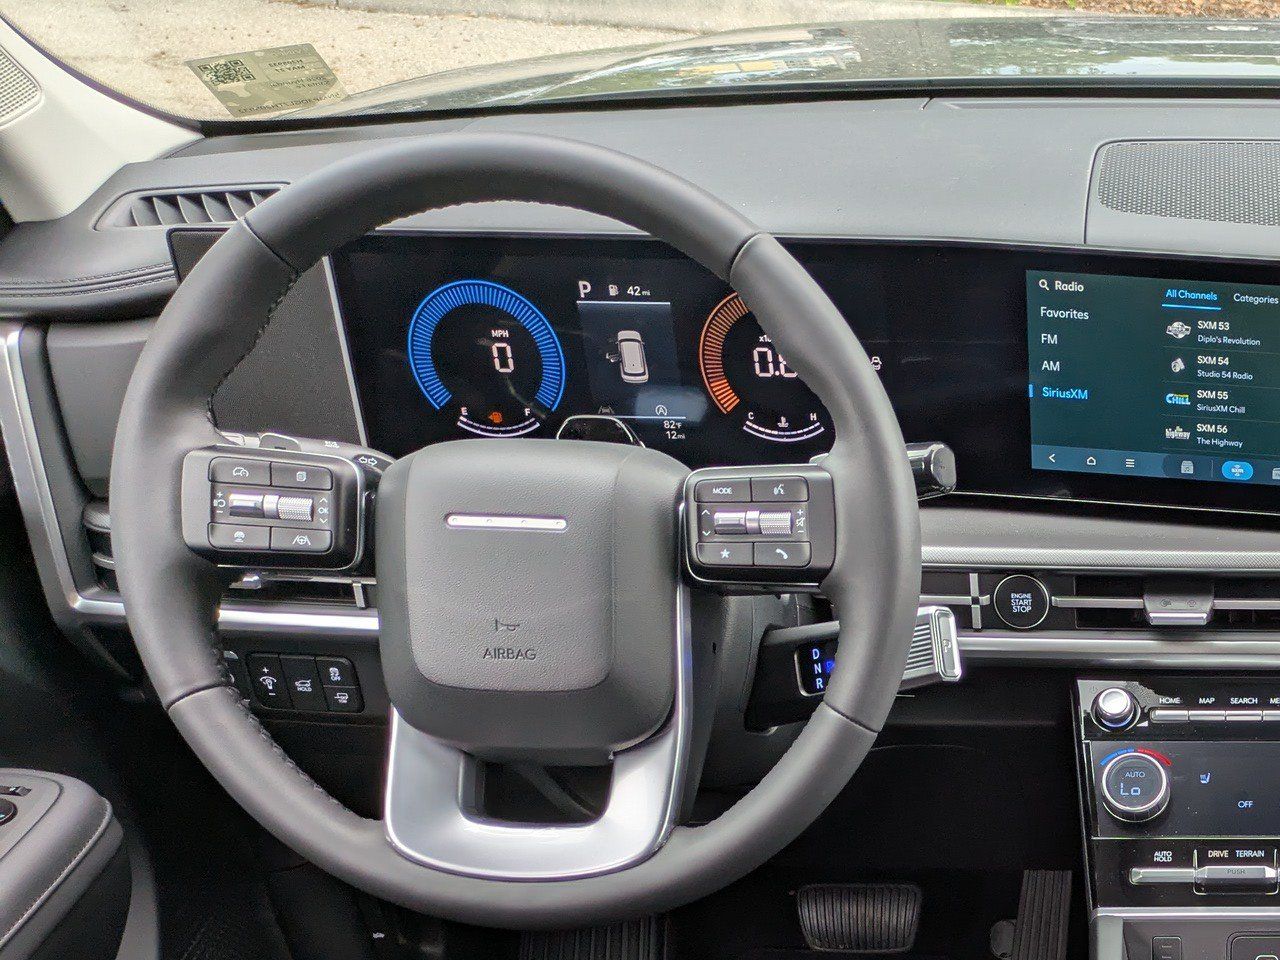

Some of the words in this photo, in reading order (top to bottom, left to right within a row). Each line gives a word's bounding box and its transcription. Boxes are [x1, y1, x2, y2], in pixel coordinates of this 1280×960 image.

[578, 281, 592, 298] P
[1054, 280, 1084, 292] Radio
[1166, 289, 1176, 298] All
[1177, 290, 1218, 300] Channels
[1233, 293, 1279, 305] Categories
[1040, 306, 1089, 320] Favorites
[1197, 321, 1217, 330] SXM
[1218, 321, 1230, 331] 53
[492, 329, 509, 338] MPH
[1041, 333, 1058, 345] FM
[1197, 335, 1221, 345] Diplo's
[1222, 336, 1260, 346] Revolution
[492, 343, 515, 373] 0
[1197, 356, 1217, 365] SXM
[1218, 356, 1230, 366] 54
[1041, 360, 1060, 372] AM
[1197, 370, 1219, 378] Studio
[1221, 371, 1231, 379] 54
[1232, 372, 1253, 380] Radio
[1042, 386, 1088, 400] SiriusXM
[1197, 390, 1216, 399] SXM
[1217, 390, 1229, 400] 55
[460, 406, 468, 416] E
[524, 407, 531, 417] F
[1197, 404, 1228, 413] SiriusXM
[1229, 405, 1246, 414] Chill
[748, 412, 754, 420] C
[810, 413, 817, 421] H
[1197, 424, 1216, 433] SXM
[1216, 424, 1228, 434] 56
[1197, 437, 1209, 445] The
[1211, 438, 1243, 449] Highway
[1012, 605, 1032, 613] STOP
[482, 648, 537, 661] AIRBAG
[812, 648, 820, 660] D
[814, 662, 822, 674] N
[816, 677, 823, 689] R
[1120, 782, 1141, 796] Lo
[1208, 850, 1229, 858] DRIVE
[1236, 850, 1265, 858] TERRAIN
